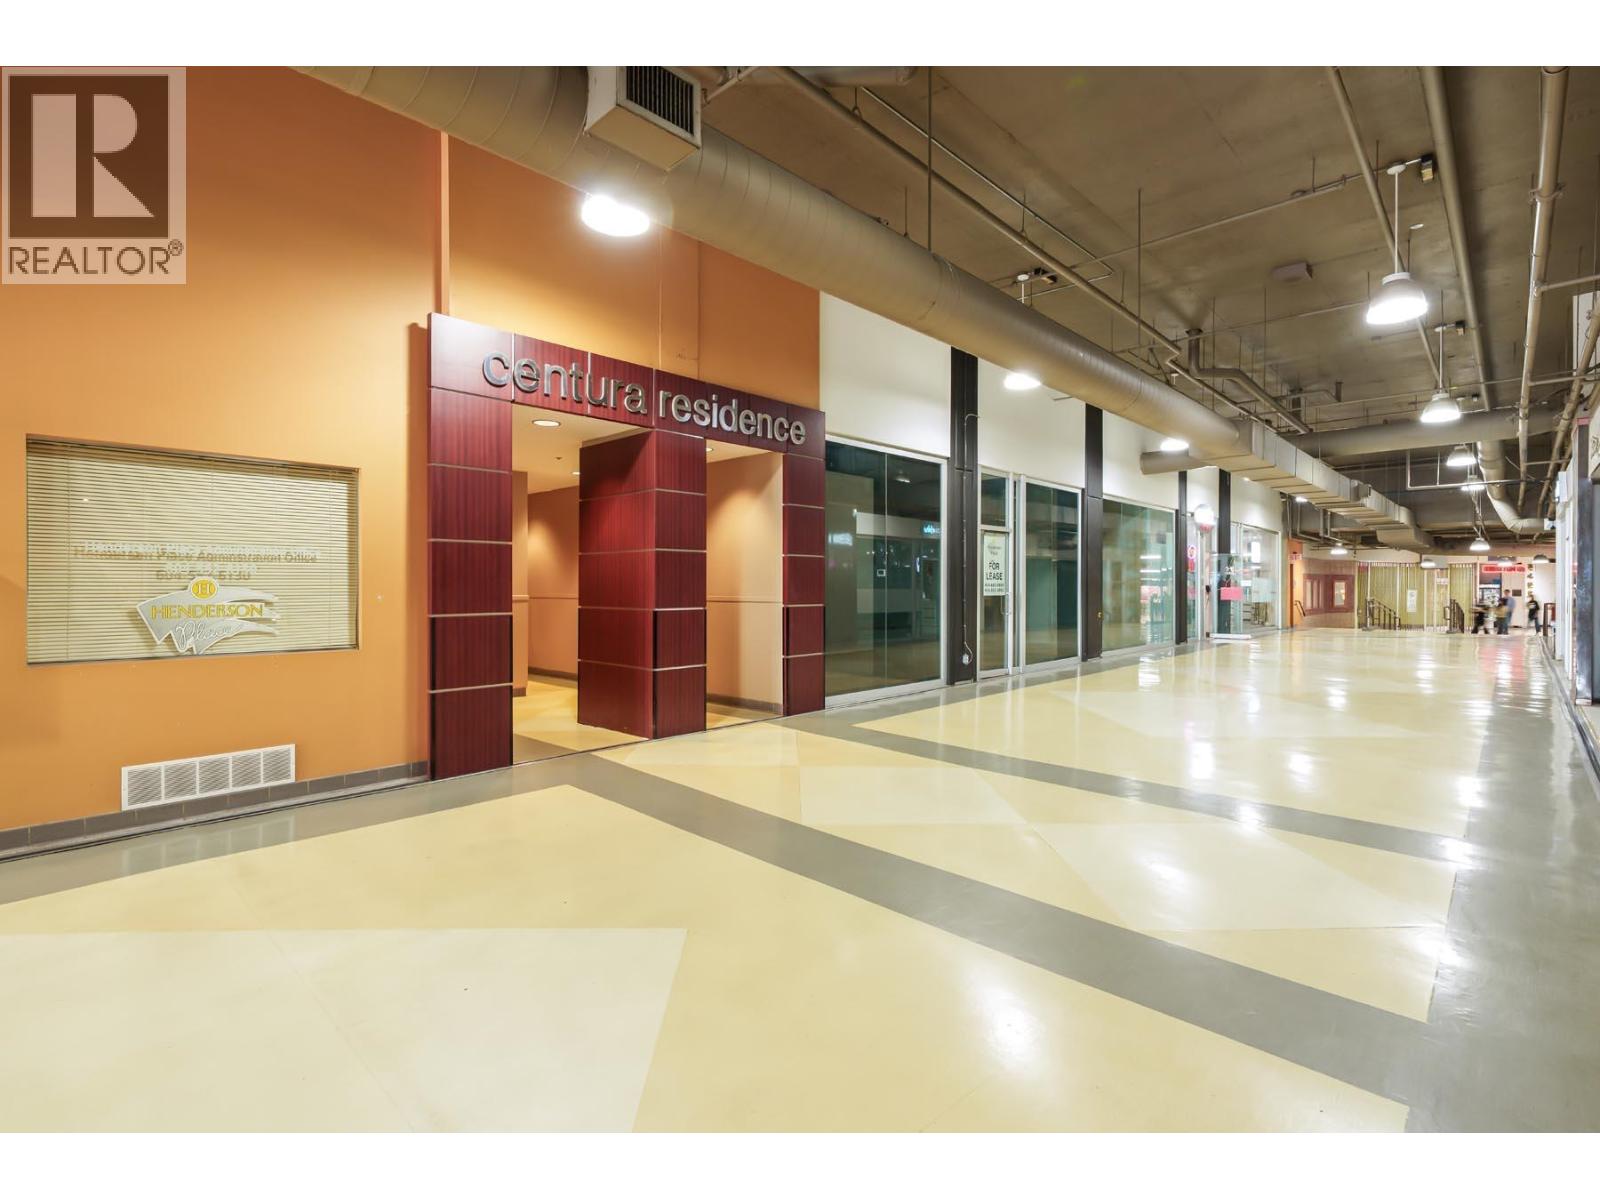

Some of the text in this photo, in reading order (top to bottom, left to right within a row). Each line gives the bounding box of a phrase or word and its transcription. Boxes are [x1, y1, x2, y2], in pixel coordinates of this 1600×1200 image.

[482, 351, 807, 445] centura residence
[988, 562, 1000, 571] FOR
[985, 572, 1003, 581] LEASE
[150, 604, 264, 620] HENDERSON
